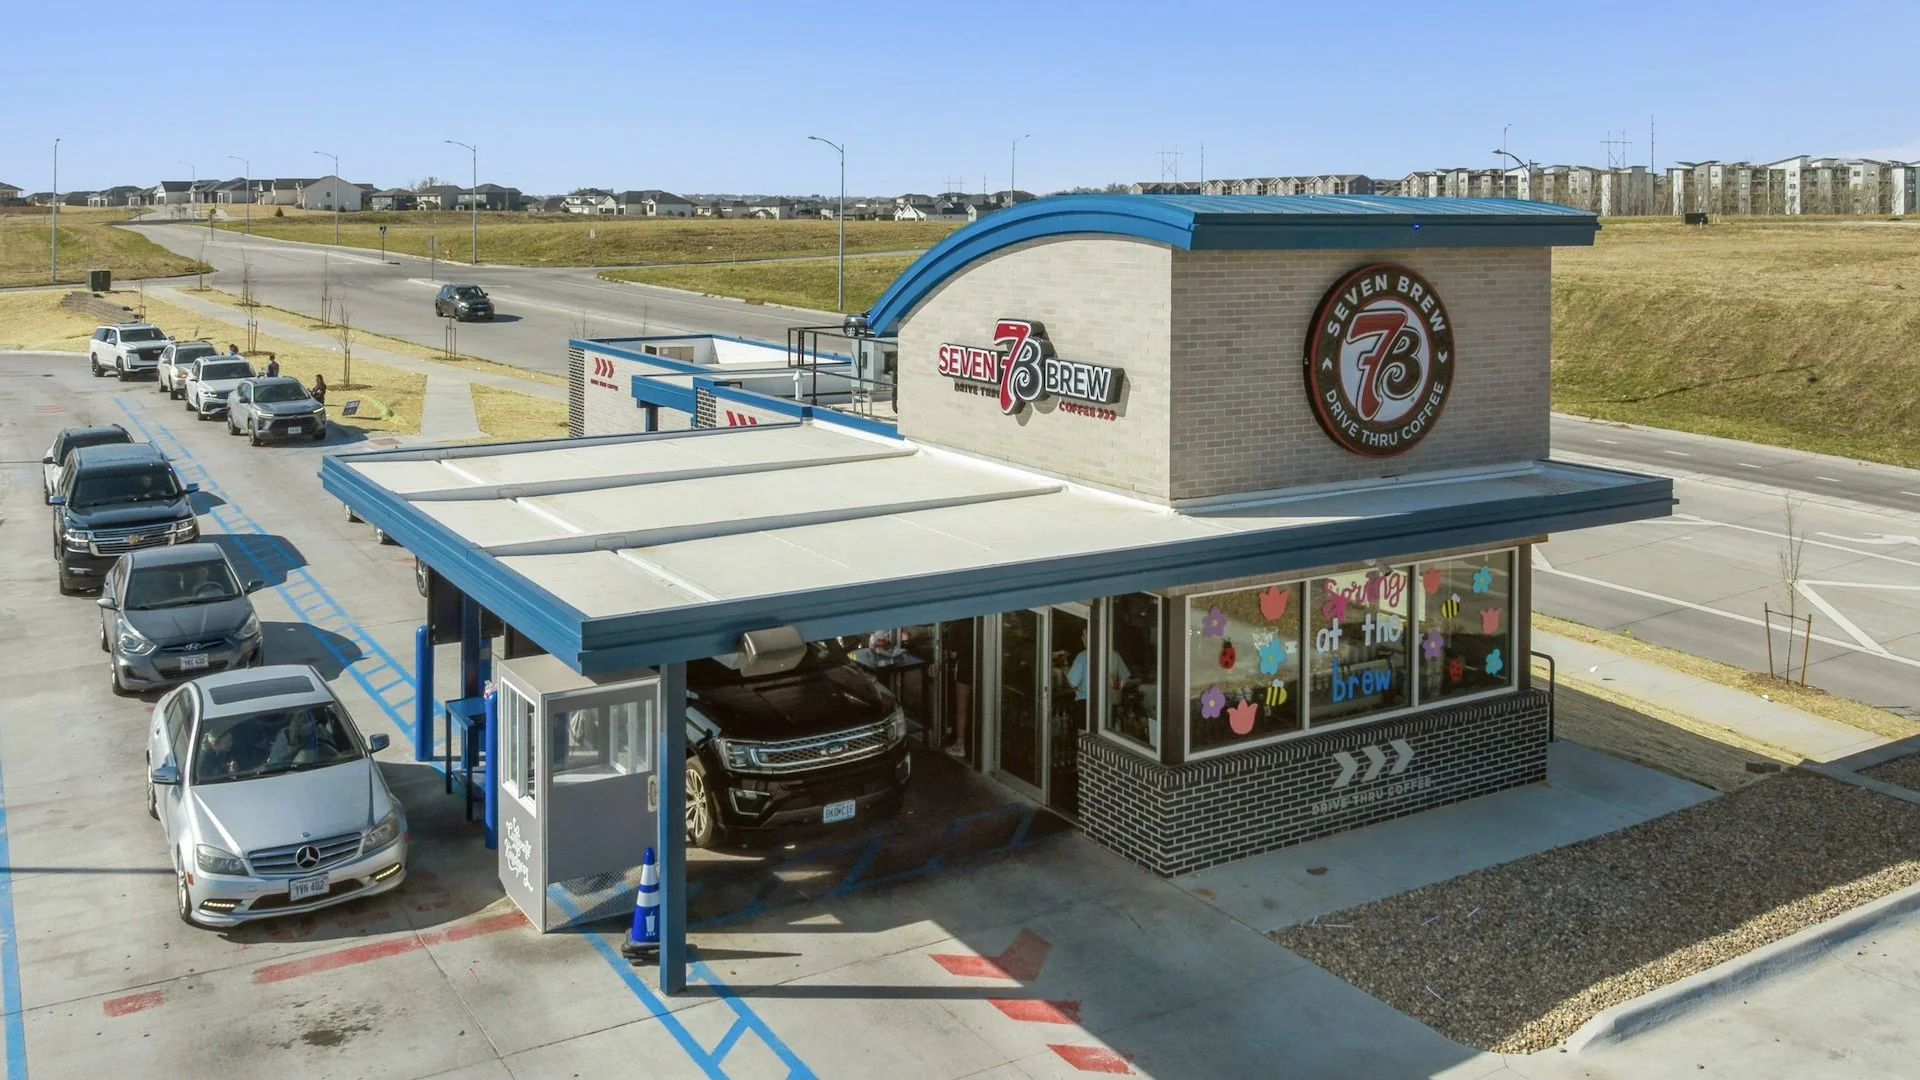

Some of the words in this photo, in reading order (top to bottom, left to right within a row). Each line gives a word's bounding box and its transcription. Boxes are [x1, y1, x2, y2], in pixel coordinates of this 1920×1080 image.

[1328, 274, 1388, 337] SEVEN
[1397, 275, 1446, 333] BREW
[938, 345, 997, 383] SEVEN
[1044, 358, 1111, 402] BREW
[954, 381, 979, 396] DRIVE
[1058, 399, 1097, 418] COFFEE
[1326, 388, 1360, 438] DRIVE
[1361, 428, 1399, 447] THRU
[1401, 381, 1445, 440] COFFEE
[1322, 571, 1407, 620] Spring
[1316, 617, 1343, 653] at
[1361, 612, 1402, 647] the
[1332, 655, 1392, 703] brew
[1311, 796, 1348, 815] DRIVE
[1351, 790, 1385, 806] THRU
[1387, 776, 1432, 797] COFFEE
